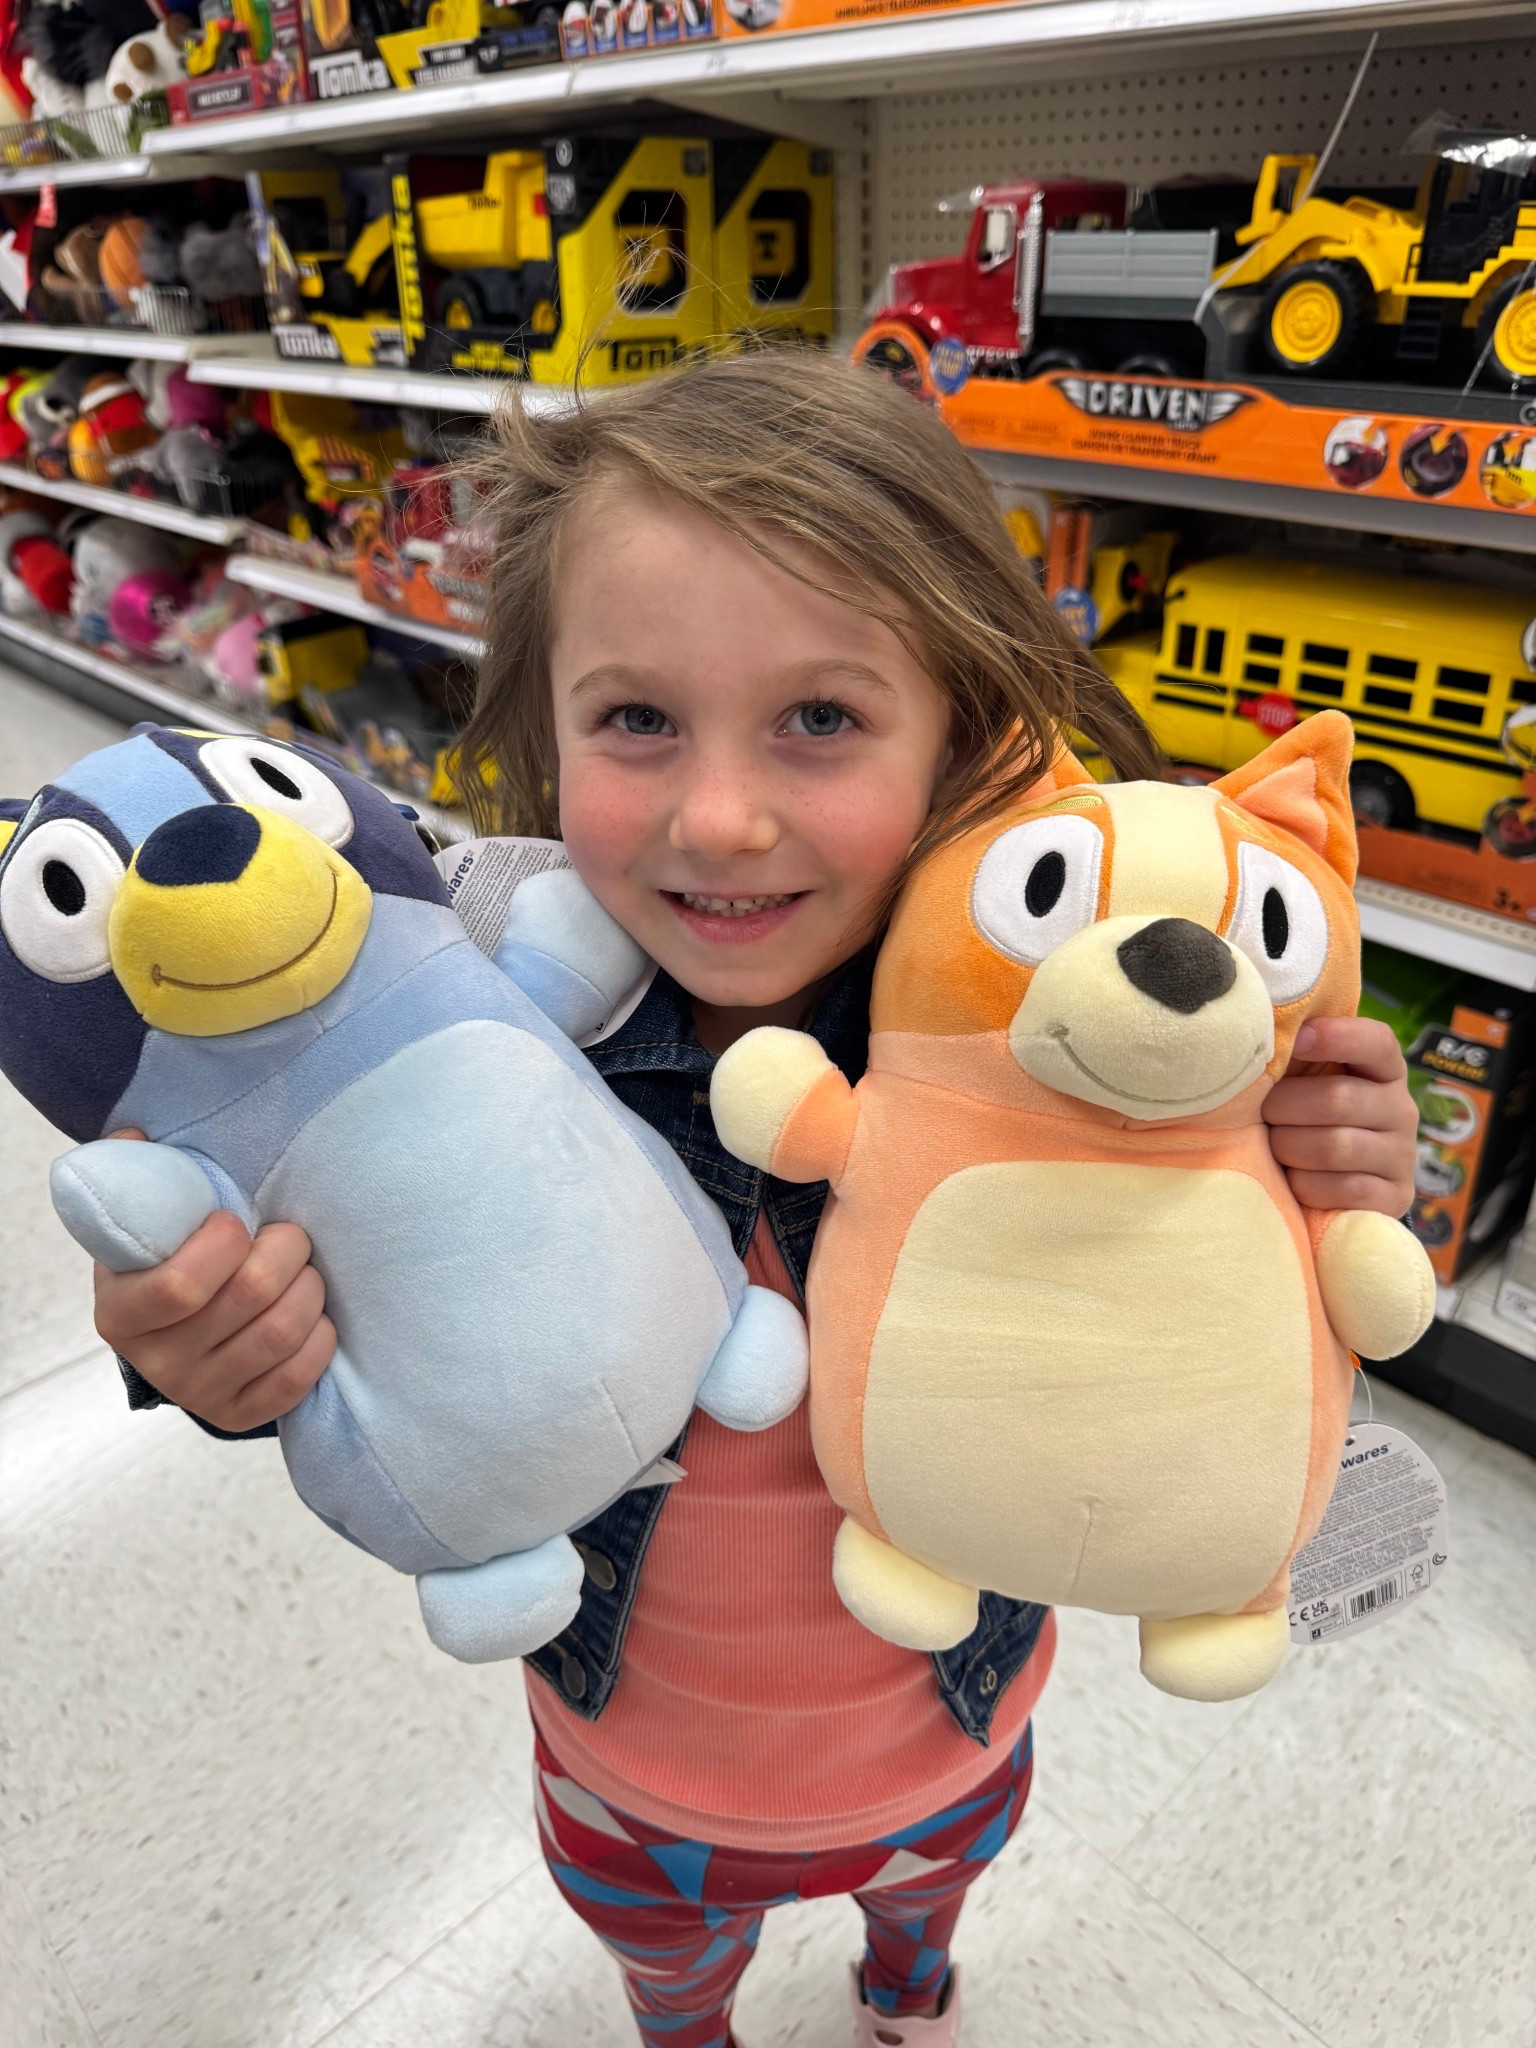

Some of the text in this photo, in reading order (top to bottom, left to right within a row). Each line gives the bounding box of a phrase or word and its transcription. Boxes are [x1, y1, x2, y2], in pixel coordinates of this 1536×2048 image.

[308, 49, 391, 99] Tonka
[1087, 380, 1207, 422] DRIVEN
[1257, 703, 1292, 729] STOP
